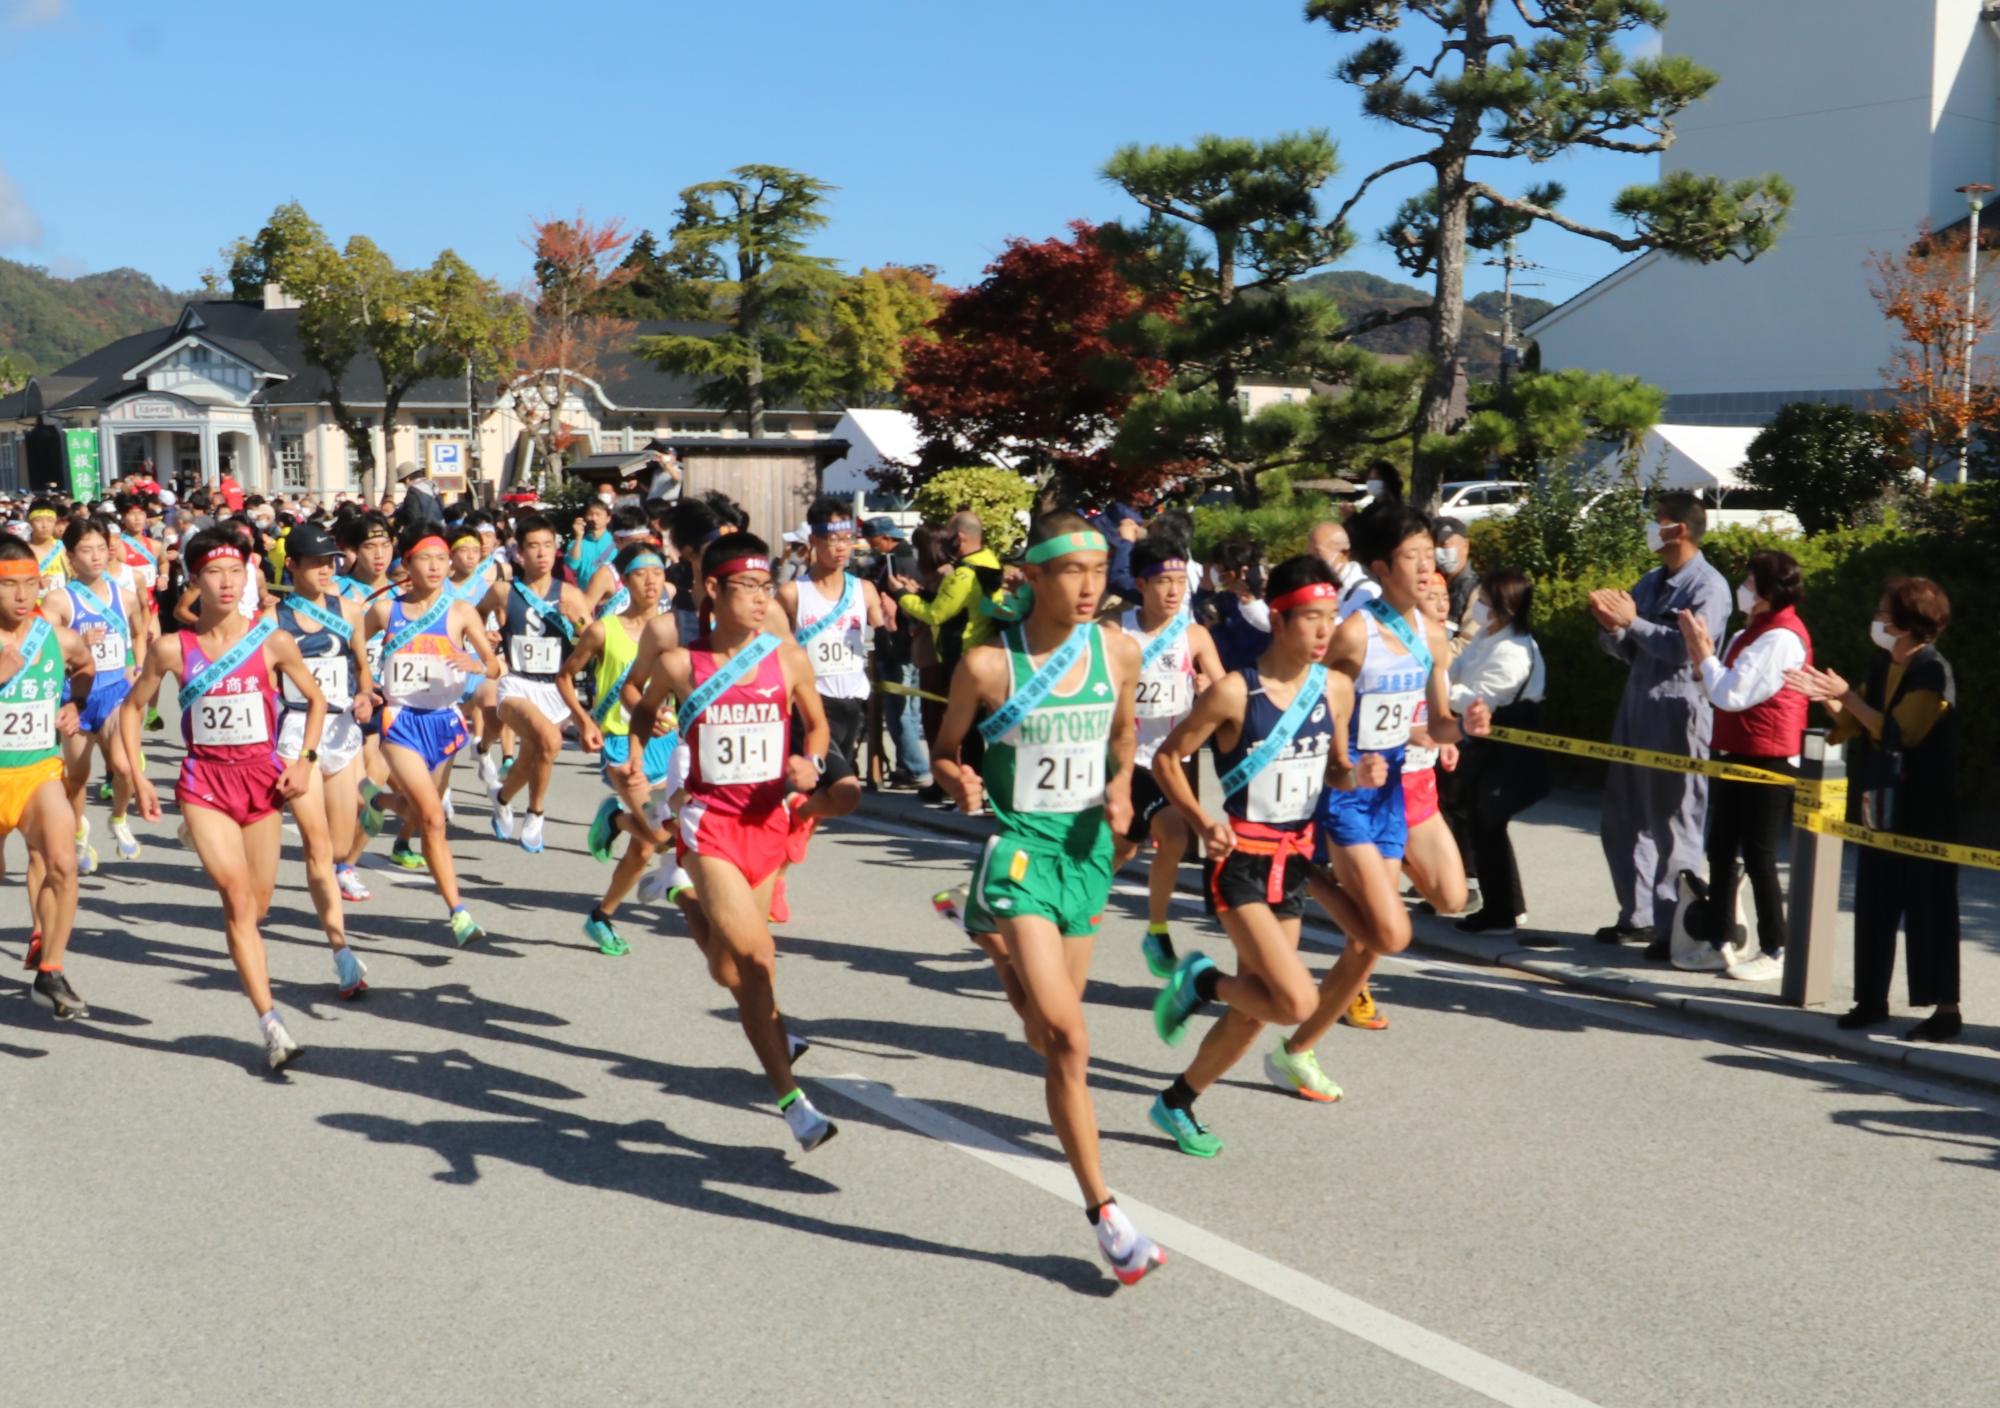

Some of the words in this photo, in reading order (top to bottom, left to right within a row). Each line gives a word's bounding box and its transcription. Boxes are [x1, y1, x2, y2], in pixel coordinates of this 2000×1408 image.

[438, 446, 456, 462] P
[523, 643, 551, 662] 9-1
[818, 642, 855, 663] 30-1
[393, 661, 429, 683] 12-1
[209, 675, 260, 695] 戸商業
[1134, 681, 1176, 704] 22-1
[3, 711, 48, 735] 23-1
[202, 706, 252, 729] 32-1
[706, 702, 781, 724] NAGATA
[717, 736, 767, 765] 31-1
[1036, 757, 1094, 790] 21-1
[1275, 772, 1313, 802] 1-1
